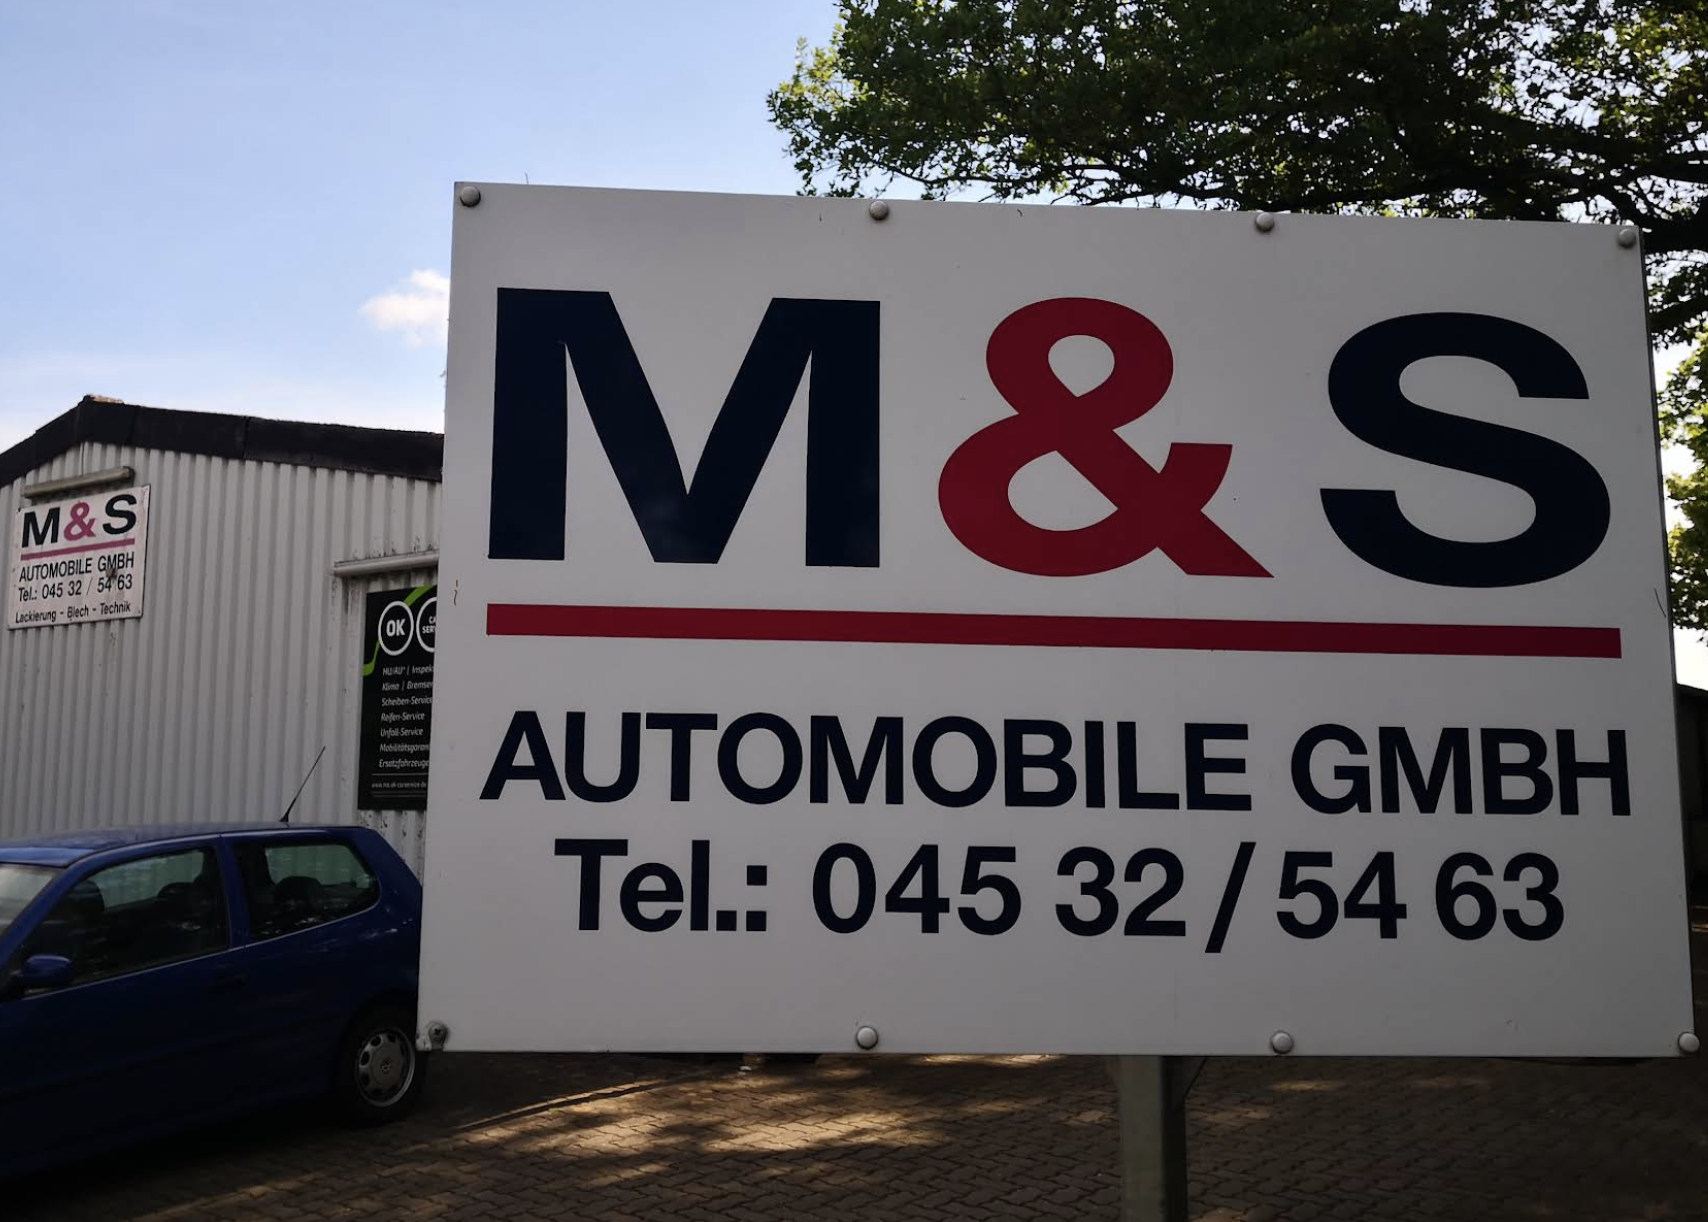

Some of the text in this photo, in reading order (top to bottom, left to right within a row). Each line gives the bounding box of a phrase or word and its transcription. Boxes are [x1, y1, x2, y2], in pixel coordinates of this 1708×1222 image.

[18, 551, 135, 582] AUTOMOBILE GMBH
[18, 586, 38, 602] Tel.:
[41, 581, 64, 600] 045
[117, 573, 133, 591] 63
[15, 609, 57, 624] Lackierung
[67, 604, 89, 619] Blech
[100, 600, 132, 616] Technik
[386, 618, 406, 637] OK
[382, 682, 400, 691] Klima
[380, 711, 425, 723] Reifen-Service
[380, 727, 424, 738] Unfall-Service
[479, 711, 1631, 816] AUTOMOBILE GMBH
[554, 838, 768, 932] Tel.:
[813, 843, 1021, 936] 045
[1435, 852, 1564, 941] 63
